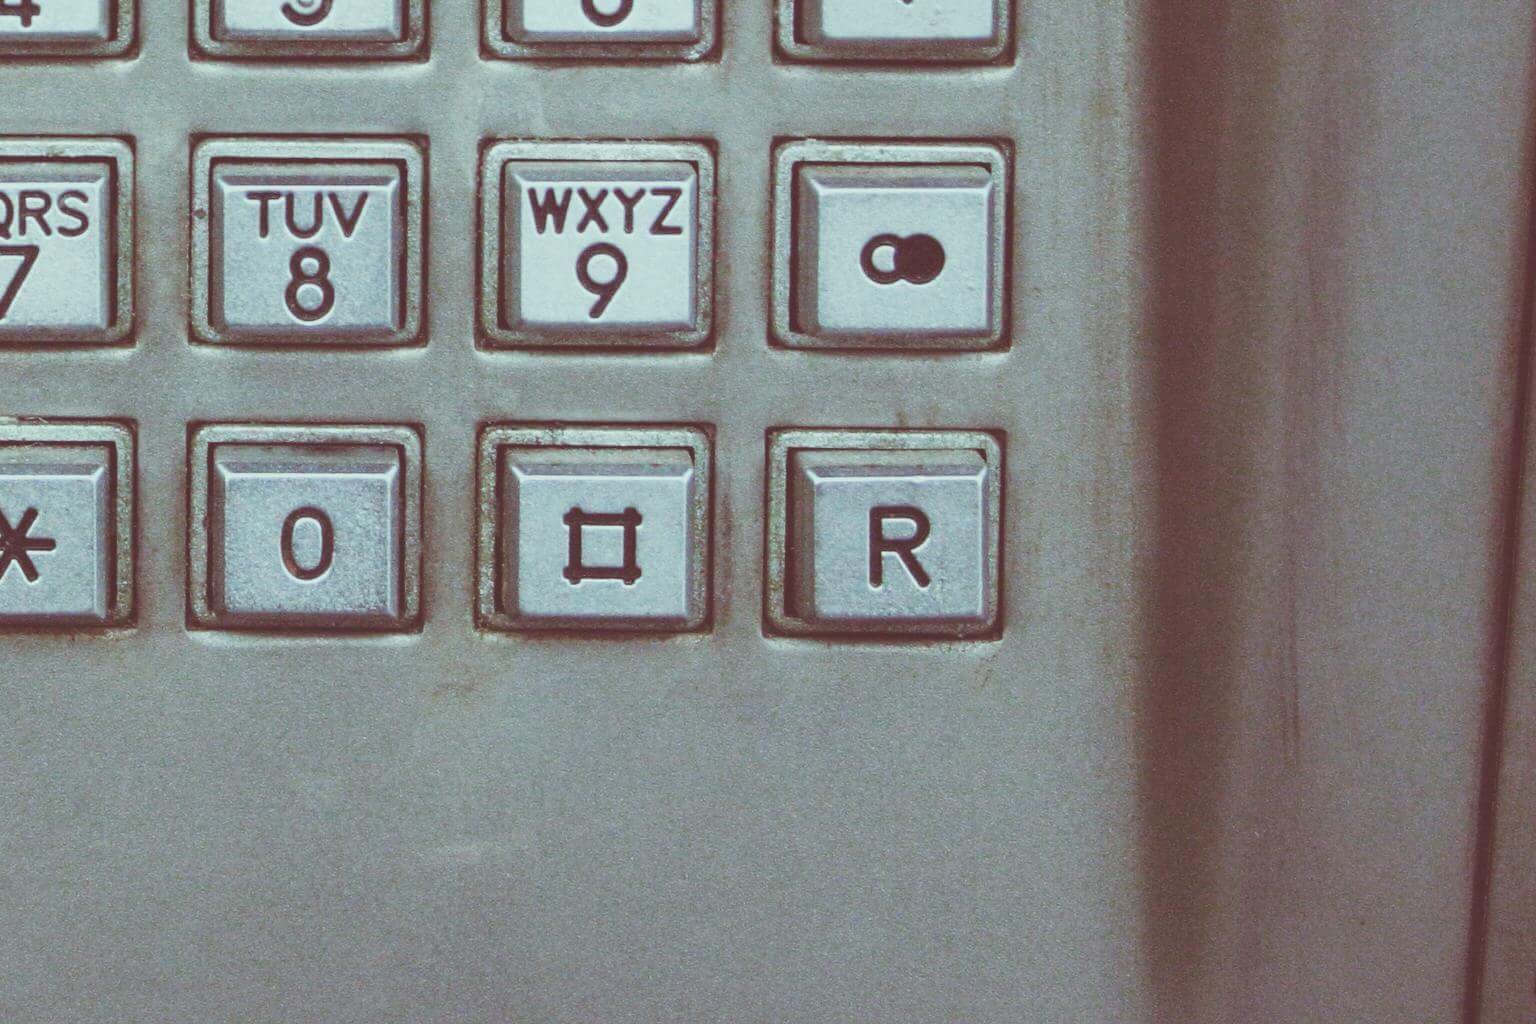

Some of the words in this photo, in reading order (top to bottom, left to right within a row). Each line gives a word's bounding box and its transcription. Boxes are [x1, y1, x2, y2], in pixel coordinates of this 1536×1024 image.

[247, 191, 369, 239] TUV
[525, 185, 685, 235] WXYZ
[285, 245, 335, 320] 8
[575, 243, 629, 320] 9
[870, 504, 931, 587] R
